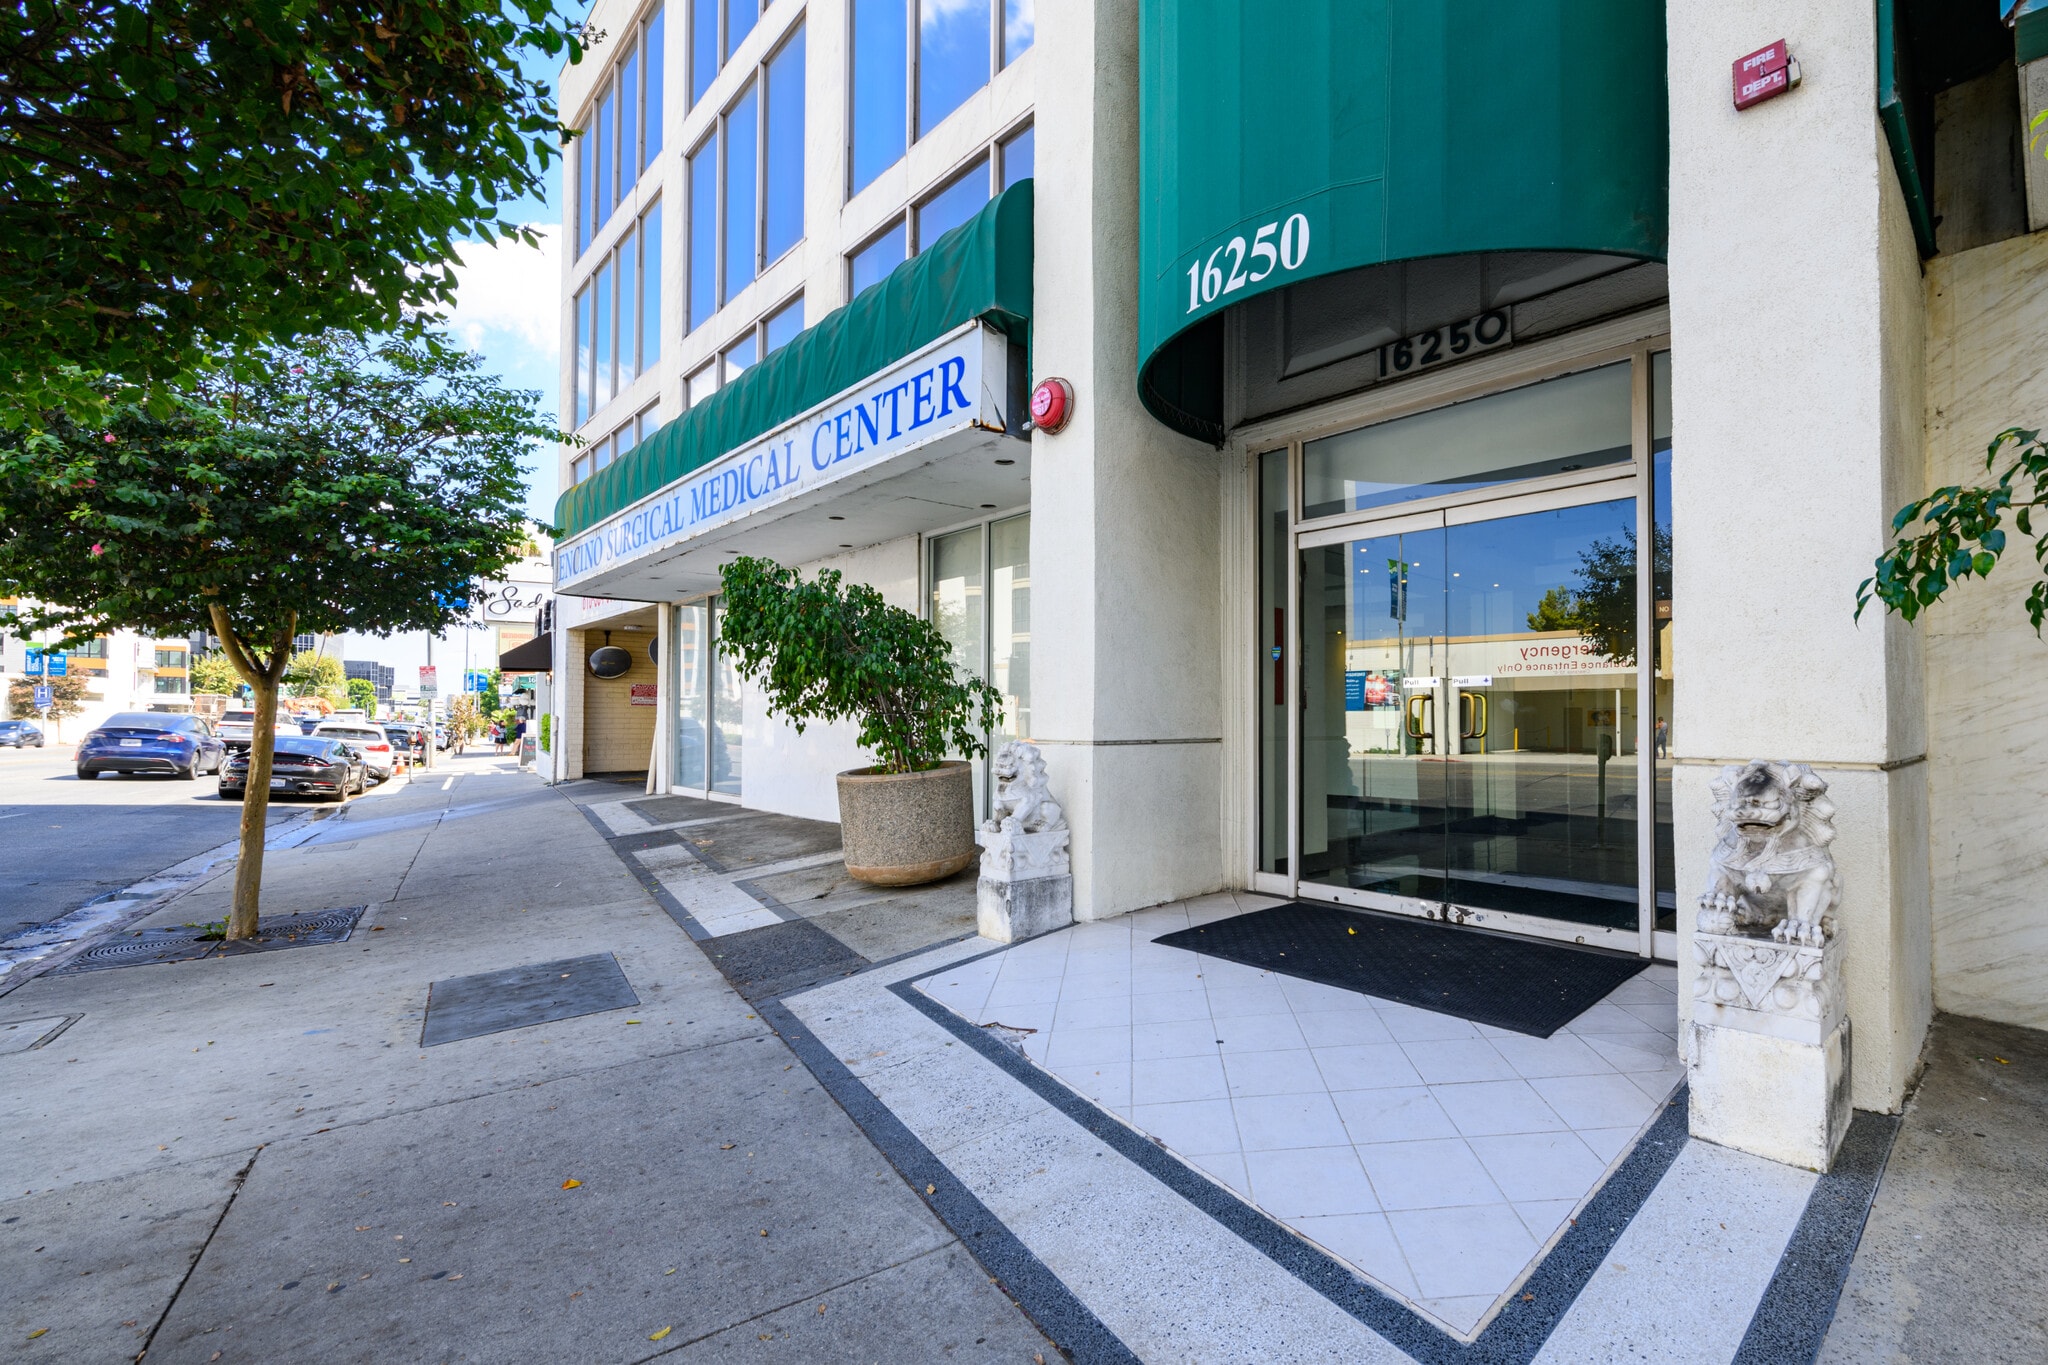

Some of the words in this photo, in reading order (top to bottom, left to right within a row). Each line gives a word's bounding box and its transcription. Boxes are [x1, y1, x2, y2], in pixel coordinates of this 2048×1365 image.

[1743, 49, 1775, 71] FIRE
[1743, 71, 1782, 96] DEPT.
[1186, 213, 1310, 314] 16250
[1380, 311, 1507, 377] 16250
[559, 536, 602, 581] ENCINO
[607, 496, 684, 561] SURGICAL
[690, 440, 800, 525] MEDICAL
[811, 356, 971, 471] CENTER
[37, 689, 48, 698] H
